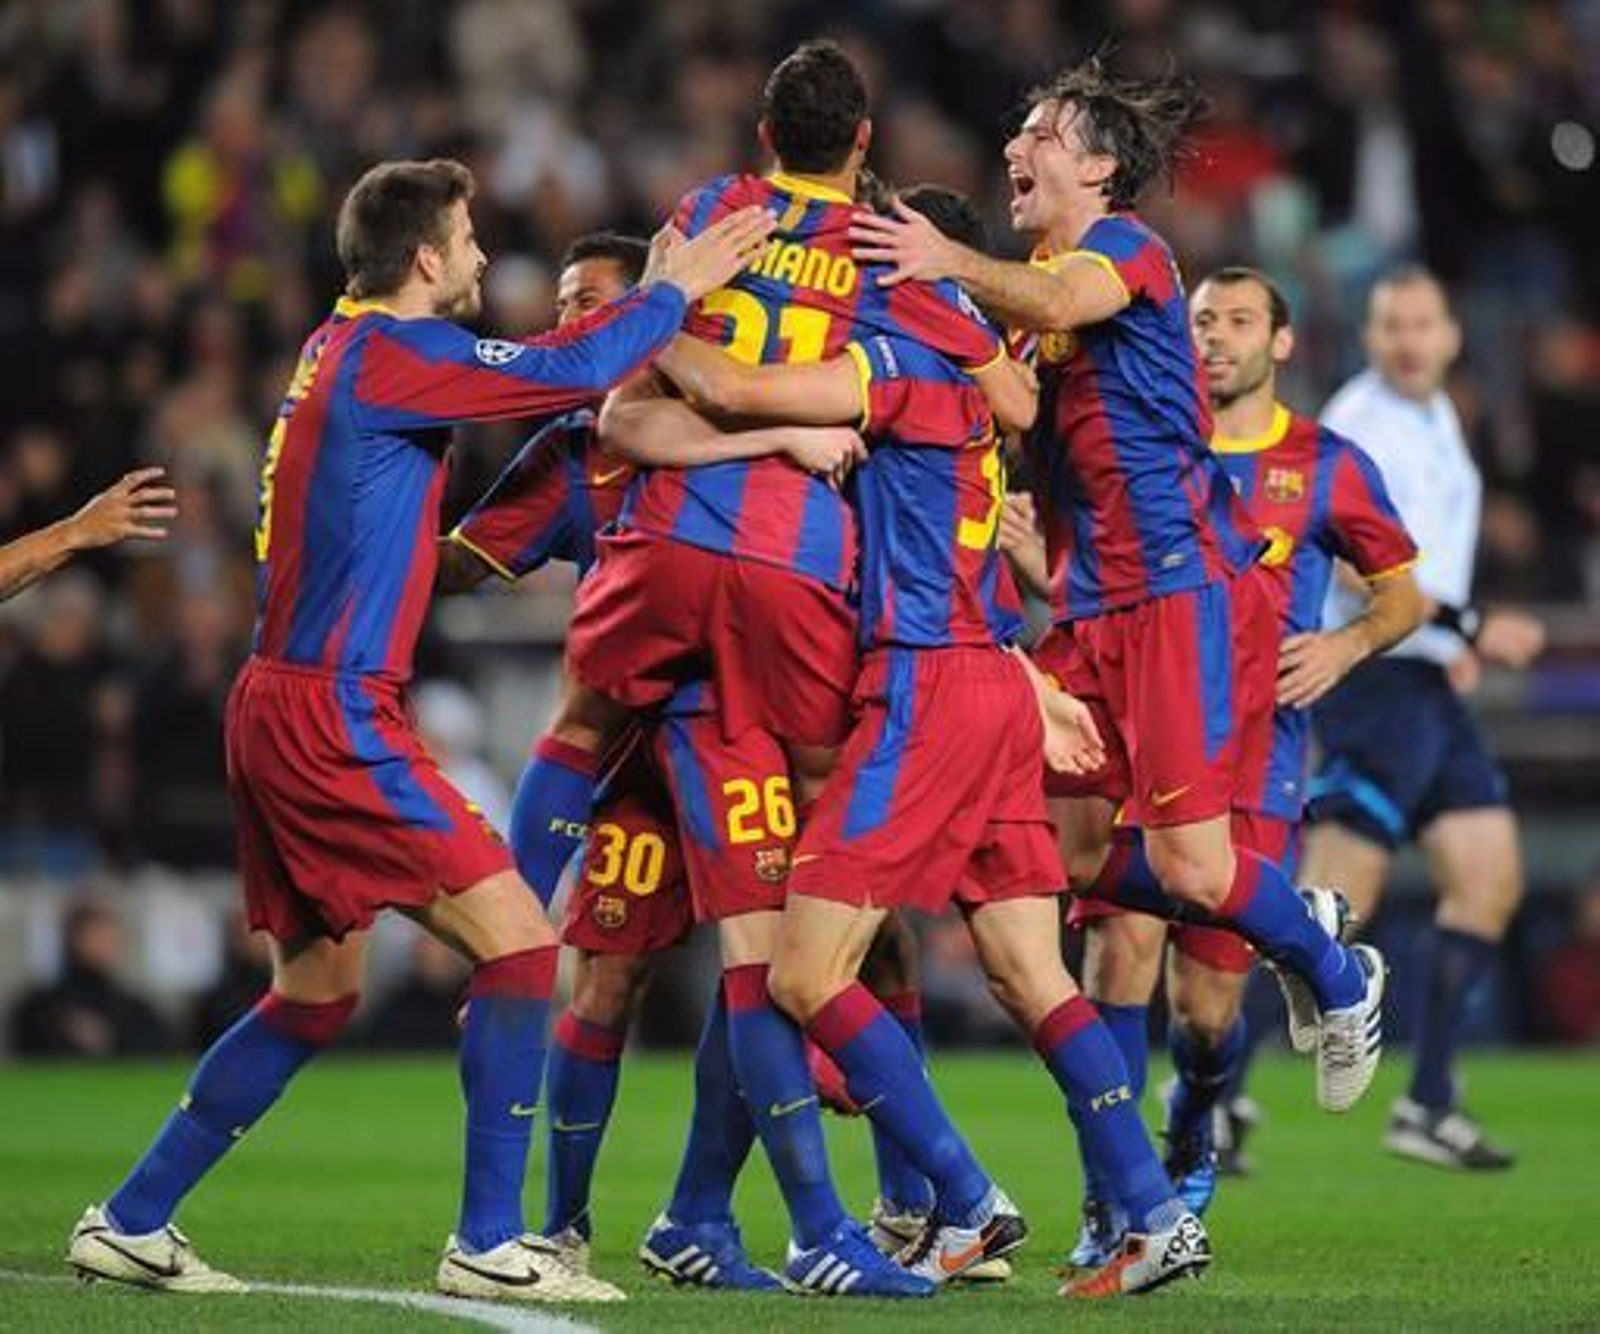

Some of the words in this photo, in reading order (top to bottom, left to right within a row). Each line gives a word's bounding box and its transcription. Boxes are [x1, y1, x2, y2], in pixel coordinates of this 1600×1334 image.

[748, 239, 857, 298] IANO
[723, 775, 797, 844] 26
[587, 822, 666, 896] 30
